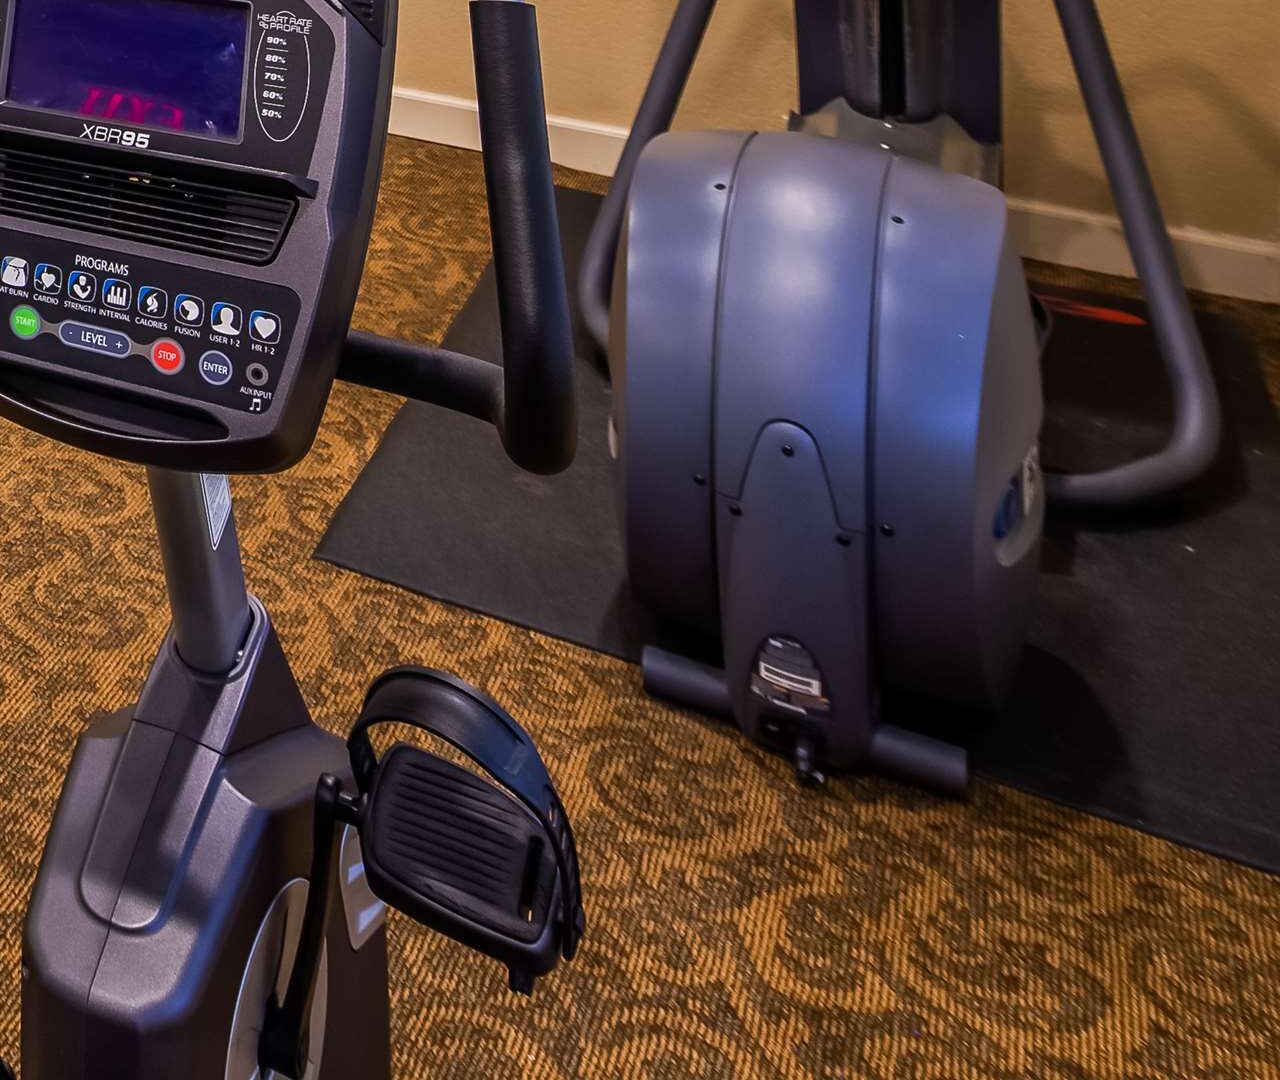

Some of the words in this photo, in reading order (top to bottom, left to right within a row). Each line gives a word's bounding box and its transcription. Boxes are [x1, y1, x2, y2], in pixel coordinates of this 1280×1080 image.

[257, 13, 289, 24] HEART
[289, 17, 313, 28] RATE
[269, 22, 311, 35] PROFILE
[266, 36, 288, 46] 90%
[264, 54, 286, 64] 80%
[264, 72, 285, 82] 70%
[262, 90, 284, 100] 60%
[261, 109, 283, 119] 50%
[79, 123, 151, 149] XBR95
[75, 254, 130, 277] PROGRAMS
[8, 288, 29, 299] BURN
[33, 293, 60, 306] CARDIO
[63, 300, 97, 314] STRENGTH
[15, 315, 36, 328] START
[98, 308, 131, 323] INTERVAL
[134, 316, 169, 331] CALORIES
[174, 325, 201, 339] FUSION
[81, 330, 108, 348] LEVEL
[209, 333, 228, 345] USER
[229, 338, 241, 348] 1-2
[157, 350, 177, 362] STOP
[251, 343, 263, 352] HR
[263, 346, 275, 356] 1-2
[203, 361, 229, 376] ENTER
[240, 386, 253, 396] AUX
[252, 389, 273, 400] INPUT
